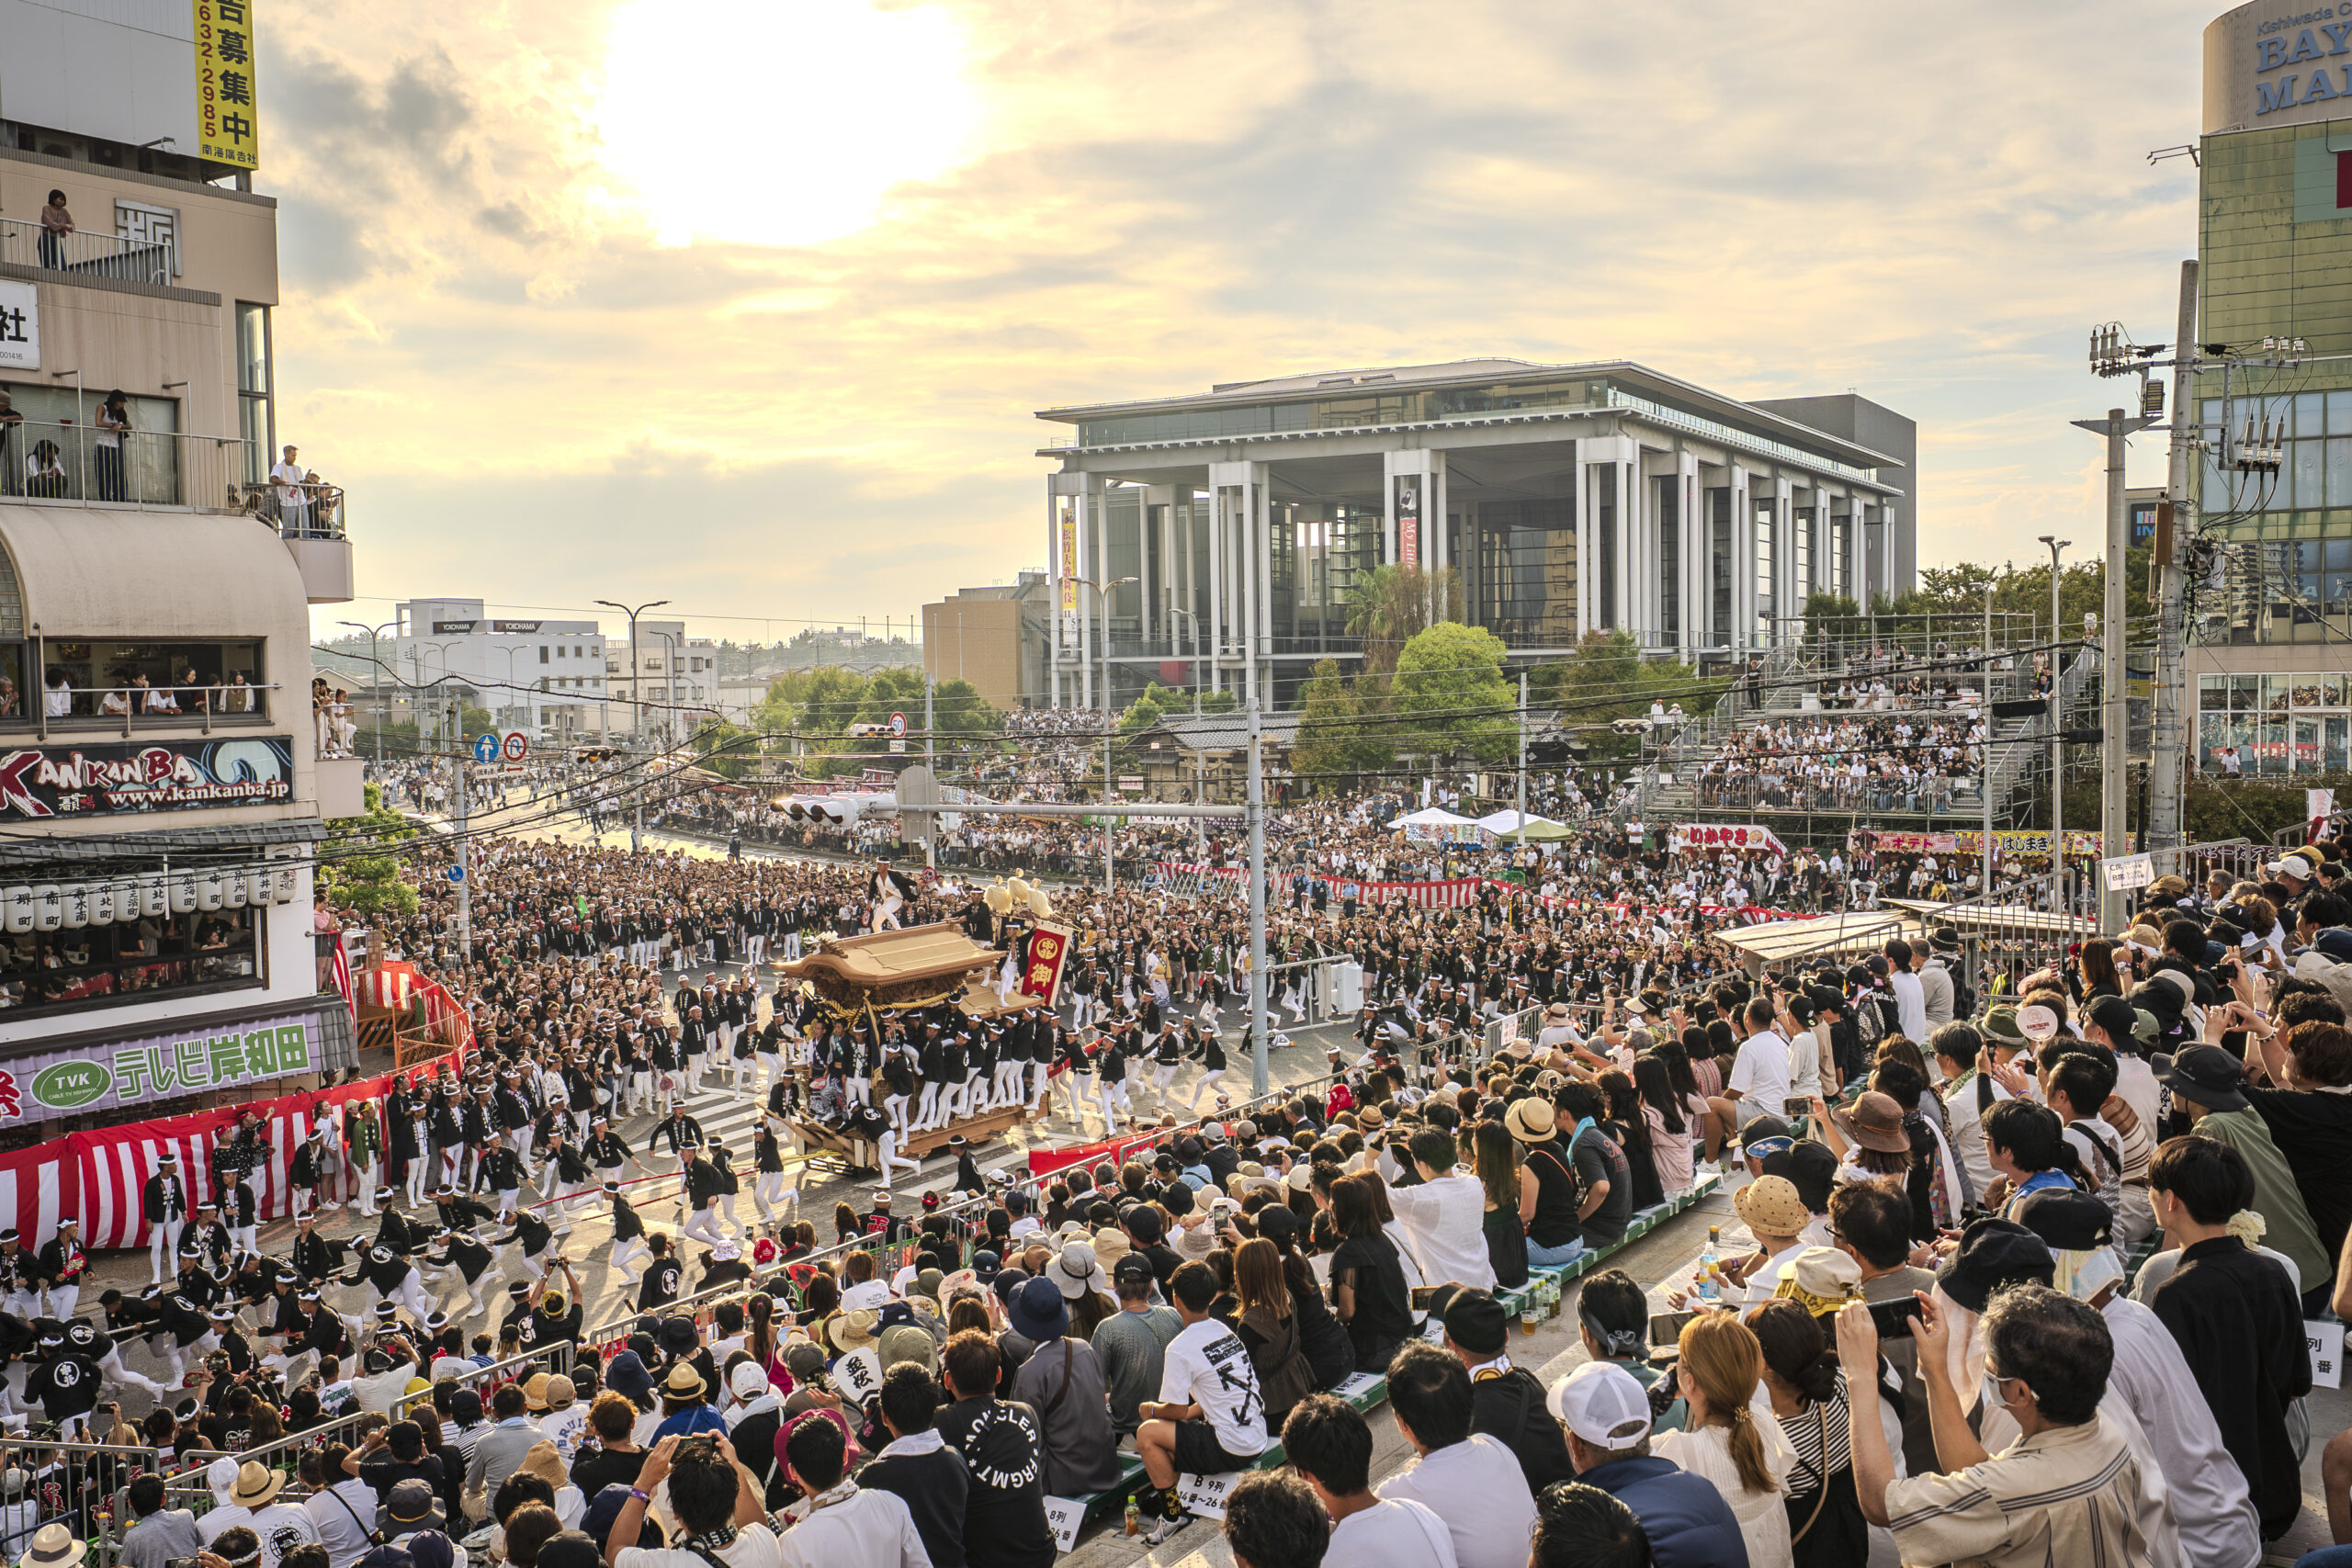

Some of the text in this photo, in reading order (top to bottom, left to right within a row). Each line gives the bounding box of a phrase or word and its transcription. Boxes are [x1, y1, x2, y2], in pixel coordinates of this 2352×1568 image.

[2256, 2, 2352, 37] Kishiwada C
[2256, 20, 2352, 73] BAY
[198, 0, 217, 138] 632-2985
[1404, 523, 1416, 541] My
[442, 623, 470, 631] YOKOHAMA
[504, 621, 536, 631] YOKOHAMA
[892, 719, 903, 732] 50
[107, 780, 289, 805] www.kankanba.jp
[1690, 827, 1748, 845] いかやき
[2001, 835, 2050, 852] はしまき
[209, 872, 222, 905] 中町
[234, 869, 246, 903] 別所町
[45, 889, 60, 926] 南町
[99, 884, 112, 919] 中北町
[1031, 963, 1053, 987] 御
[112, 1022, 311, 1101] テレビ岸和田
[55, 1072, 90, 1089] TVK
[976, 1457, 1038, 1490] FRGMT
[1193, 1475, 1227, 1493] B 9列
[1049, 1509, 1068, 1523] 8列
[1169, 1505, 1182, 1516] OFF
